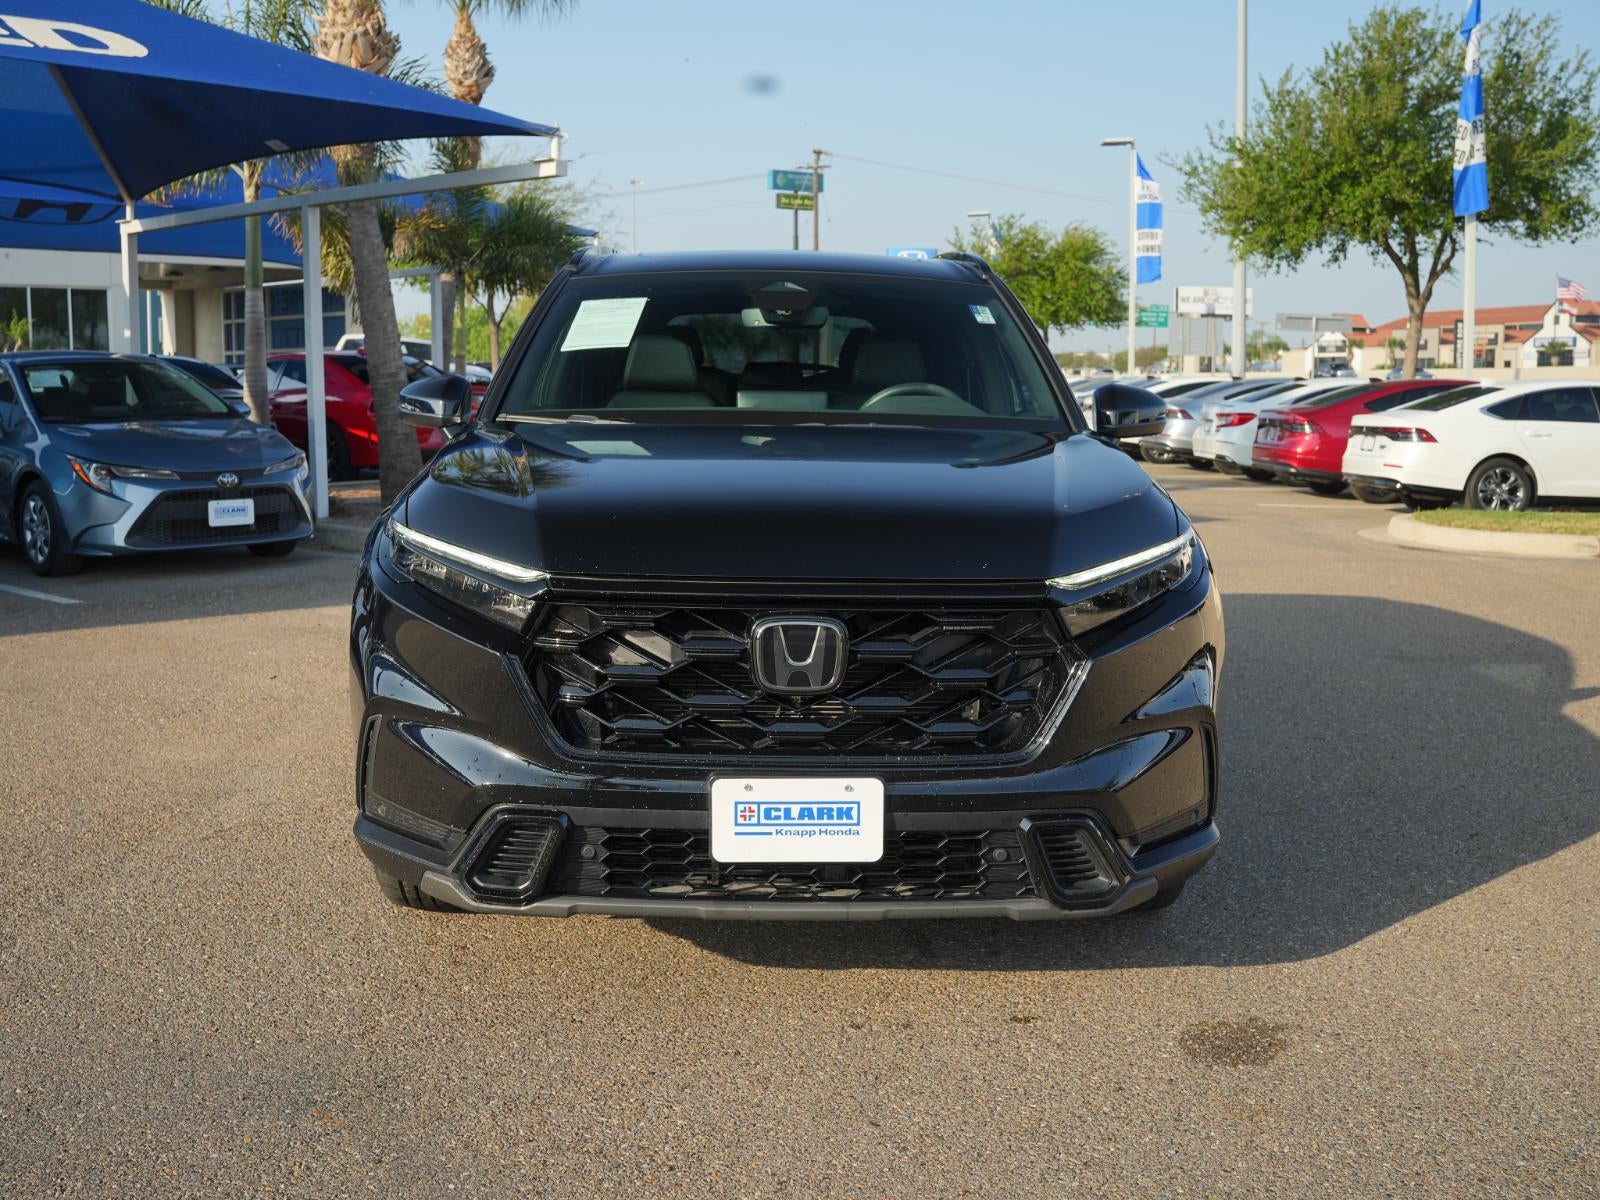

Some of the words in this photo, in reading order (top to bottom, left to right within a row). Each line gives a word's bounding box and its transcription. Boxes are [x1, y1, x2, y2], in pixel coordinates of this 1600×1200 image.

[763, 806, 855, 821] CLARK
[775, 828, 816, 838] Knapp
[818, 828, 860, 836] Honda
